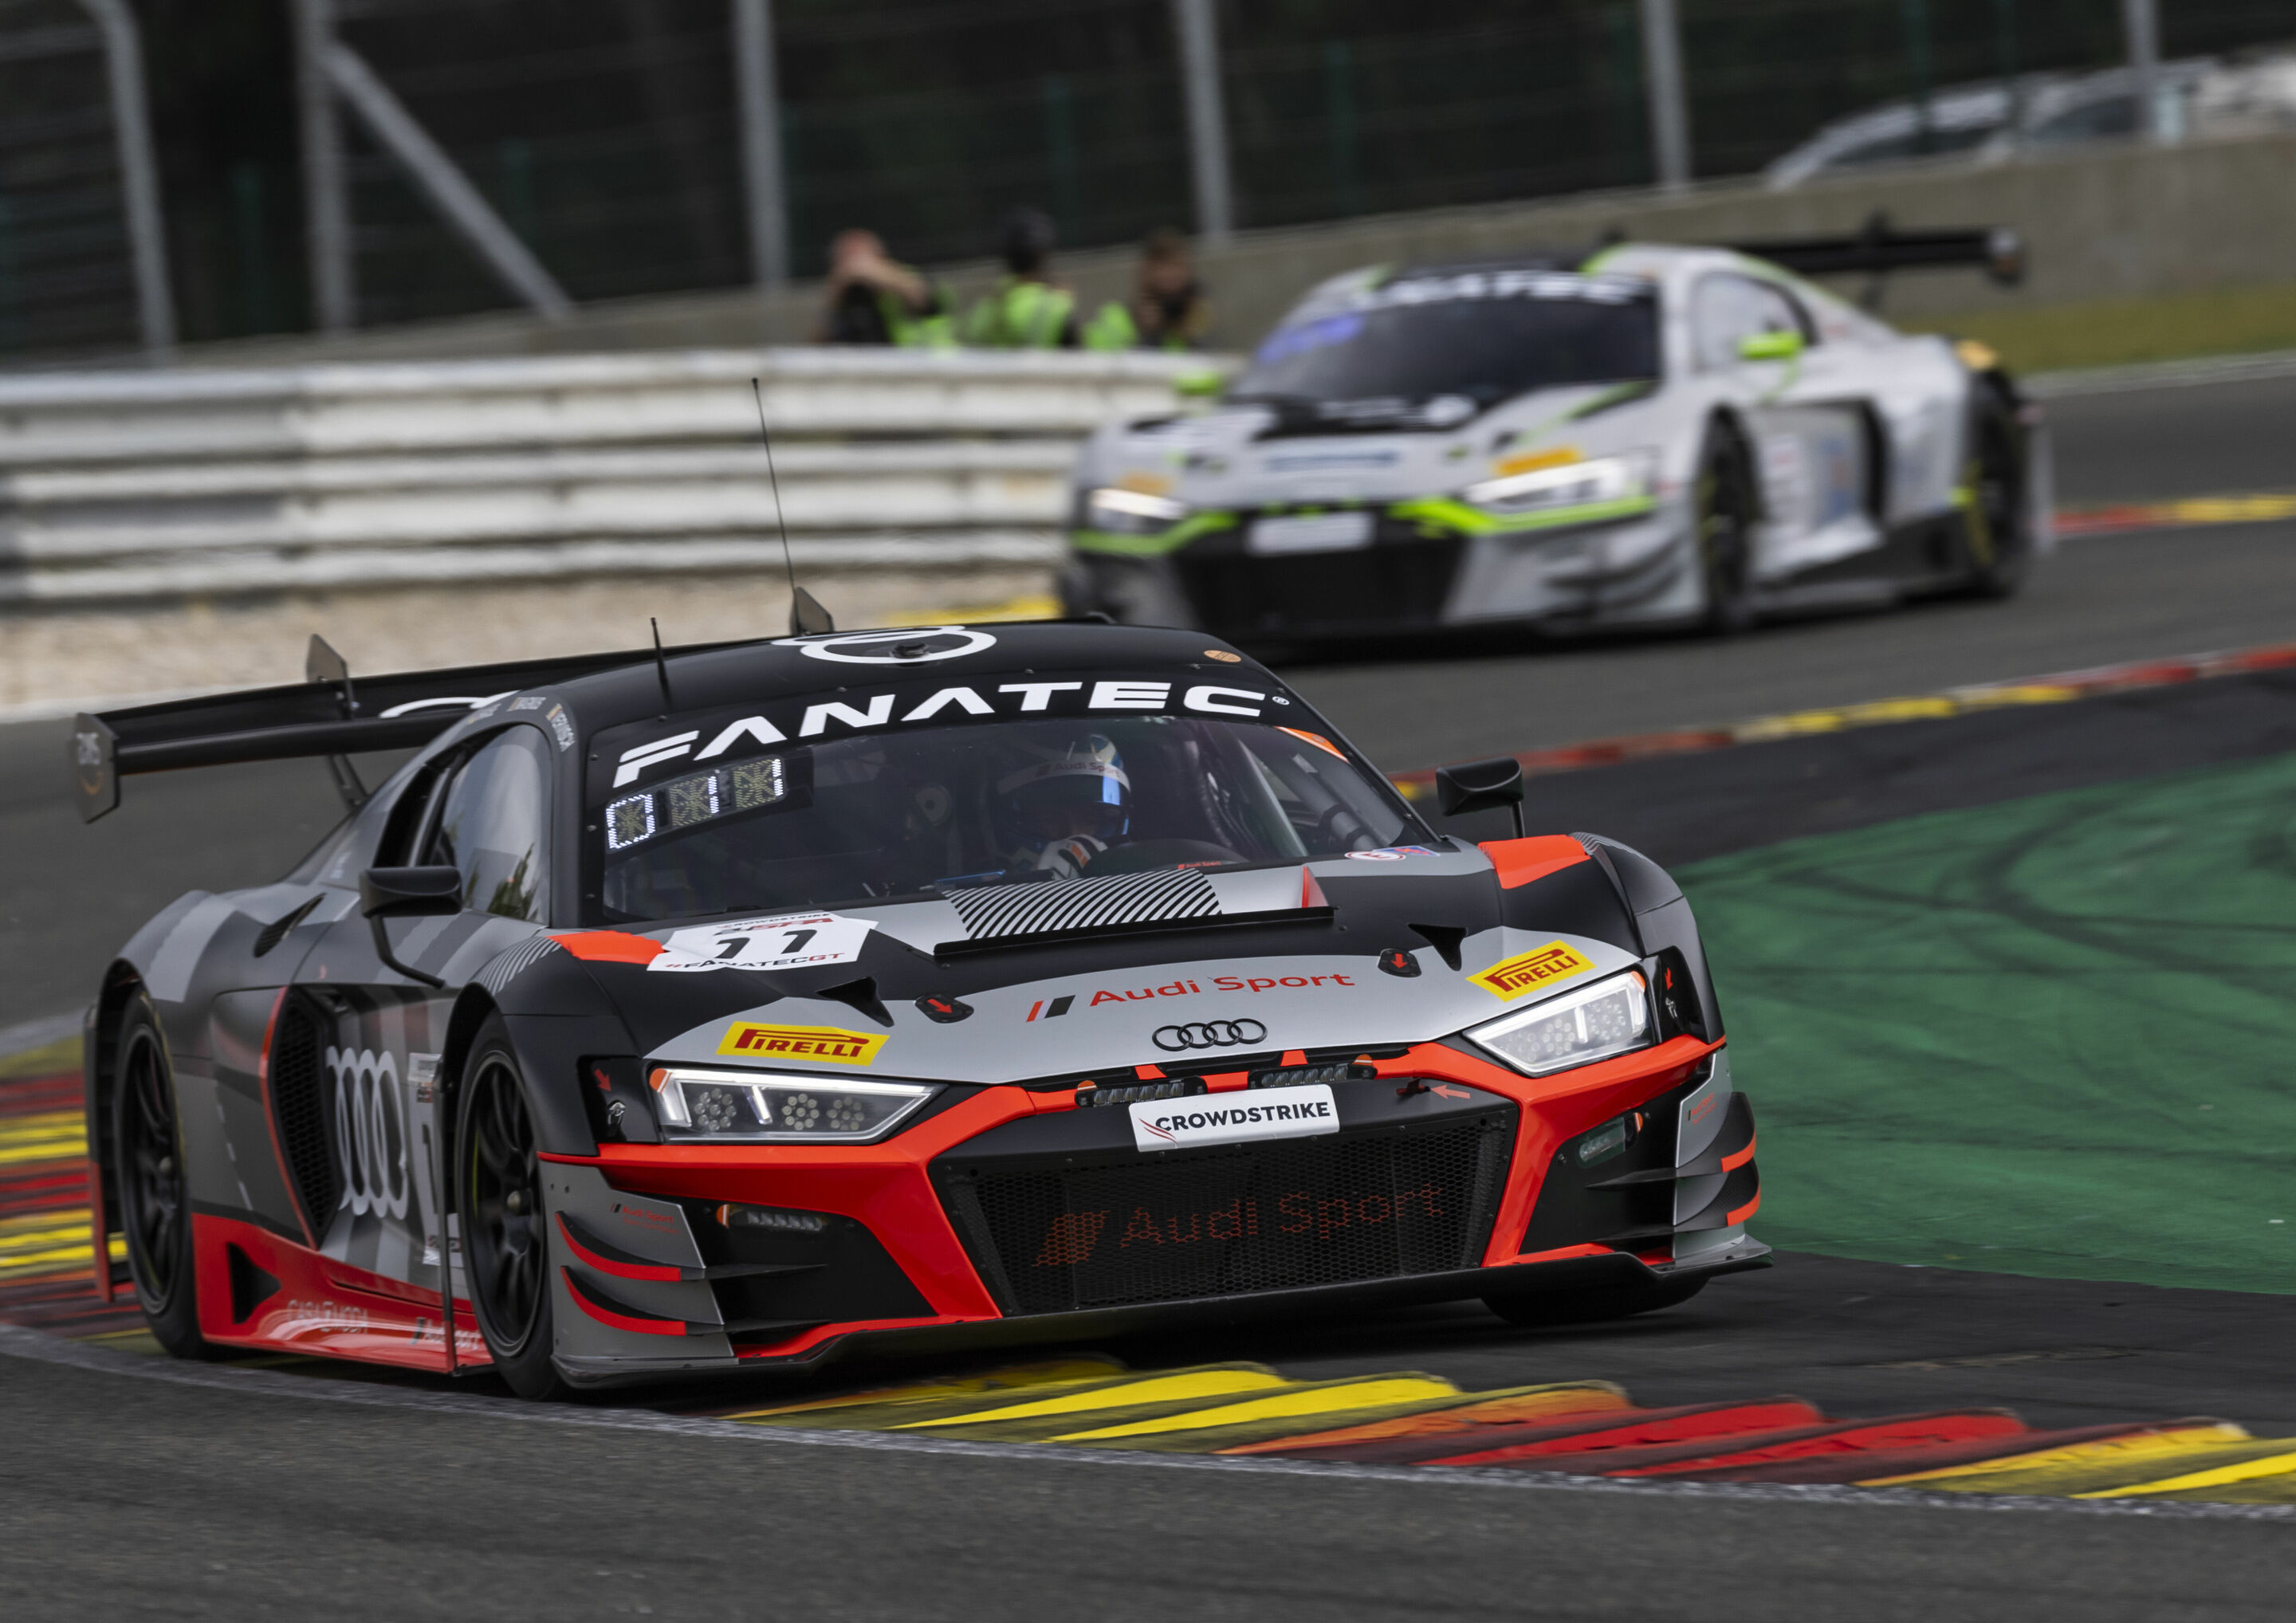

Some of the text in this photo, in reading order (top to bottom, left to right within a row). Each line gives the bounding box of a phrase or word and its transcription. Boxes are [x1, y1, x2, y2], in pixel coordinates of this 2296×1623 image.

[714, 929, 818, 960] 11
[1483, 948, 1580, 992] PIRELLI
[1089, 973, 1355, 1007] Audi Sport
[733, 1028, 871, 1058] PIRELLI
[1155, 1102, 1331, 1131] CROWDSTRIKE
[1120, 1183, 1444, 1249] Audi Sport
